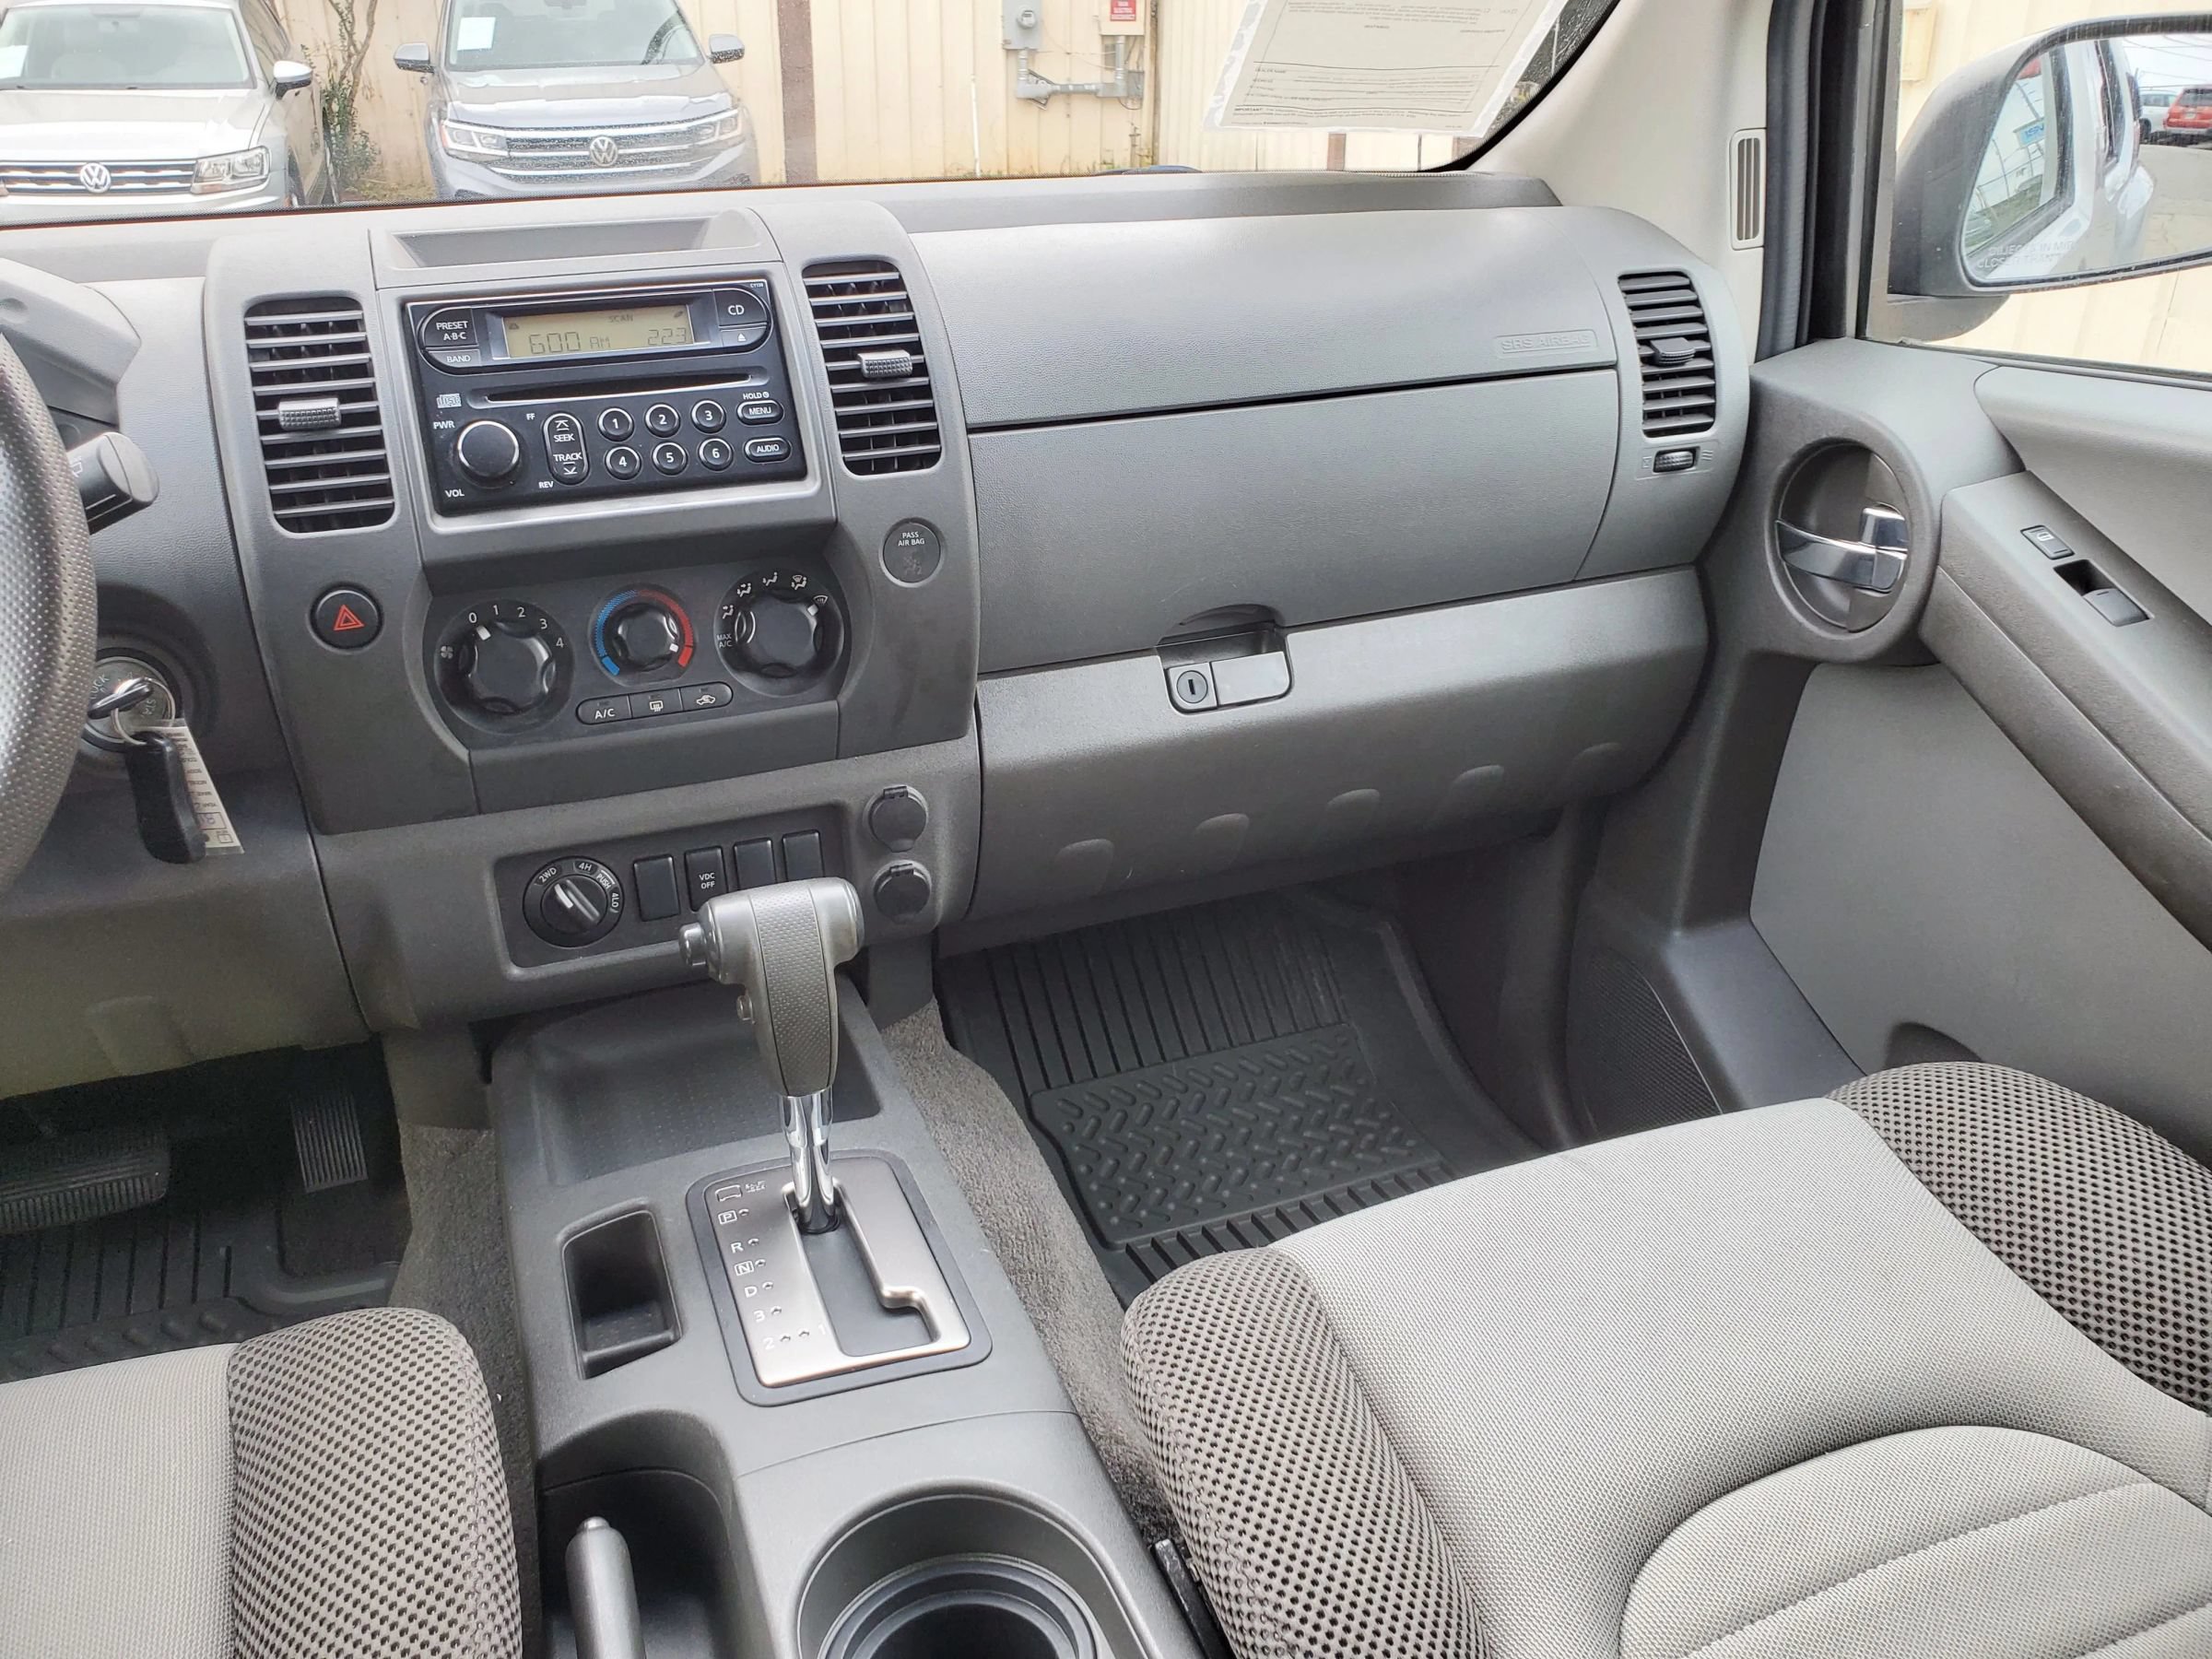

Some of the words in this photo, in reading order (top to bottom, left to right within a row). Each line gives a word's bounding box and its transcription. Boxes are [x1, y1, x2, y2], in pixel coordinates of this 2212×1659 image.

[728, 304, 745, 315] CD
[436, 321, 468, 330] PRESET
[529, 332, 581, 354] 600
[447, 355, 471, 363] BAND
[743, 392, 762, 400] HOLD
[704, 410, 713, 421] 3
[749, 406, 771, 415] MENU
[433, 420, 455, 429] PWR
[612, 418, 619, 429] 1
[658, 415, 667, 425] 2
[554, 434, 575, 442] SEEK
[712, 448, 720, 459] 6
[757, 444, 779, 453] AUDIO
[554, 452, 582, 462] TRACK
[618, 456, 628, 467] 4
[665, 453, 674, 464] 5
[538, 480, 553, 488] REV
[444, 489, 465, 498] VOL
[492, 605, 500, 615] 1
[516, 606, 526, 618] 2
[468, 612, 477, 623] 0
[539, 618, 548, 629] 3
[555, 637, 564, 648] 4
[594, 708, 616, 719] A/C
[579, 862, 593, 872] 4H
[538, 867, 558, 883] 2WD
[699, 872, 715, 881] VDC
[596, 873, 612, 890] PUSH
[700, 880, 715, 889] OFF
[731, 1241, 744, 1253] R
[744, 1287, 757, 1298] D
[754, 1310, 765, 1323] 3
[763, 1337, 775, 1350] 2
